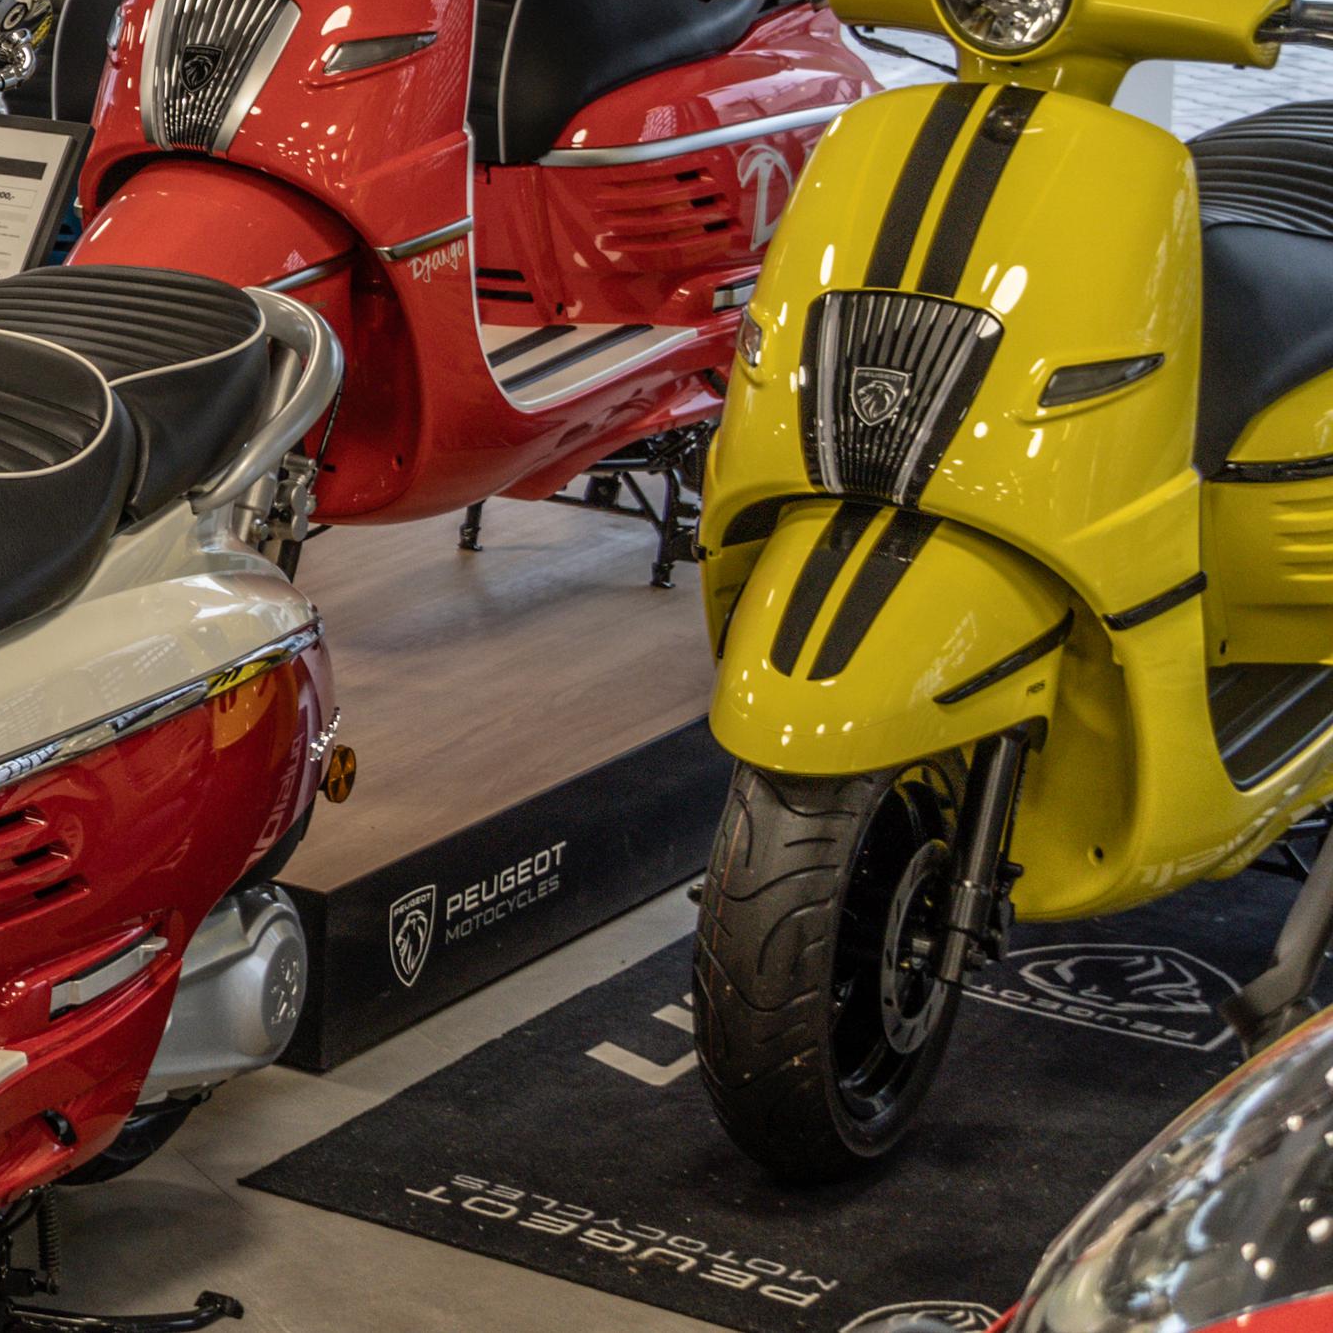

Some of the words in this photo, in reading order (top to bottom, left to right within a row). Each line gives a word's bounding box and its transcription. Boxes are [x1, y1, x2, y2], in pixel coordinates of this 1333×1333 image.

[393, 891, 432, 918] PEUGEOT
[445, 873, 560, 946] MOTOCYCLES
[446, 840, 567, 921] PEUGEOT
[969, 983, 1198, 1041] PEUGEOT
[405, 1185, 822, 1309] PEUGEOT
[451, 1173, 839, 1292] MOTOCYCLES
